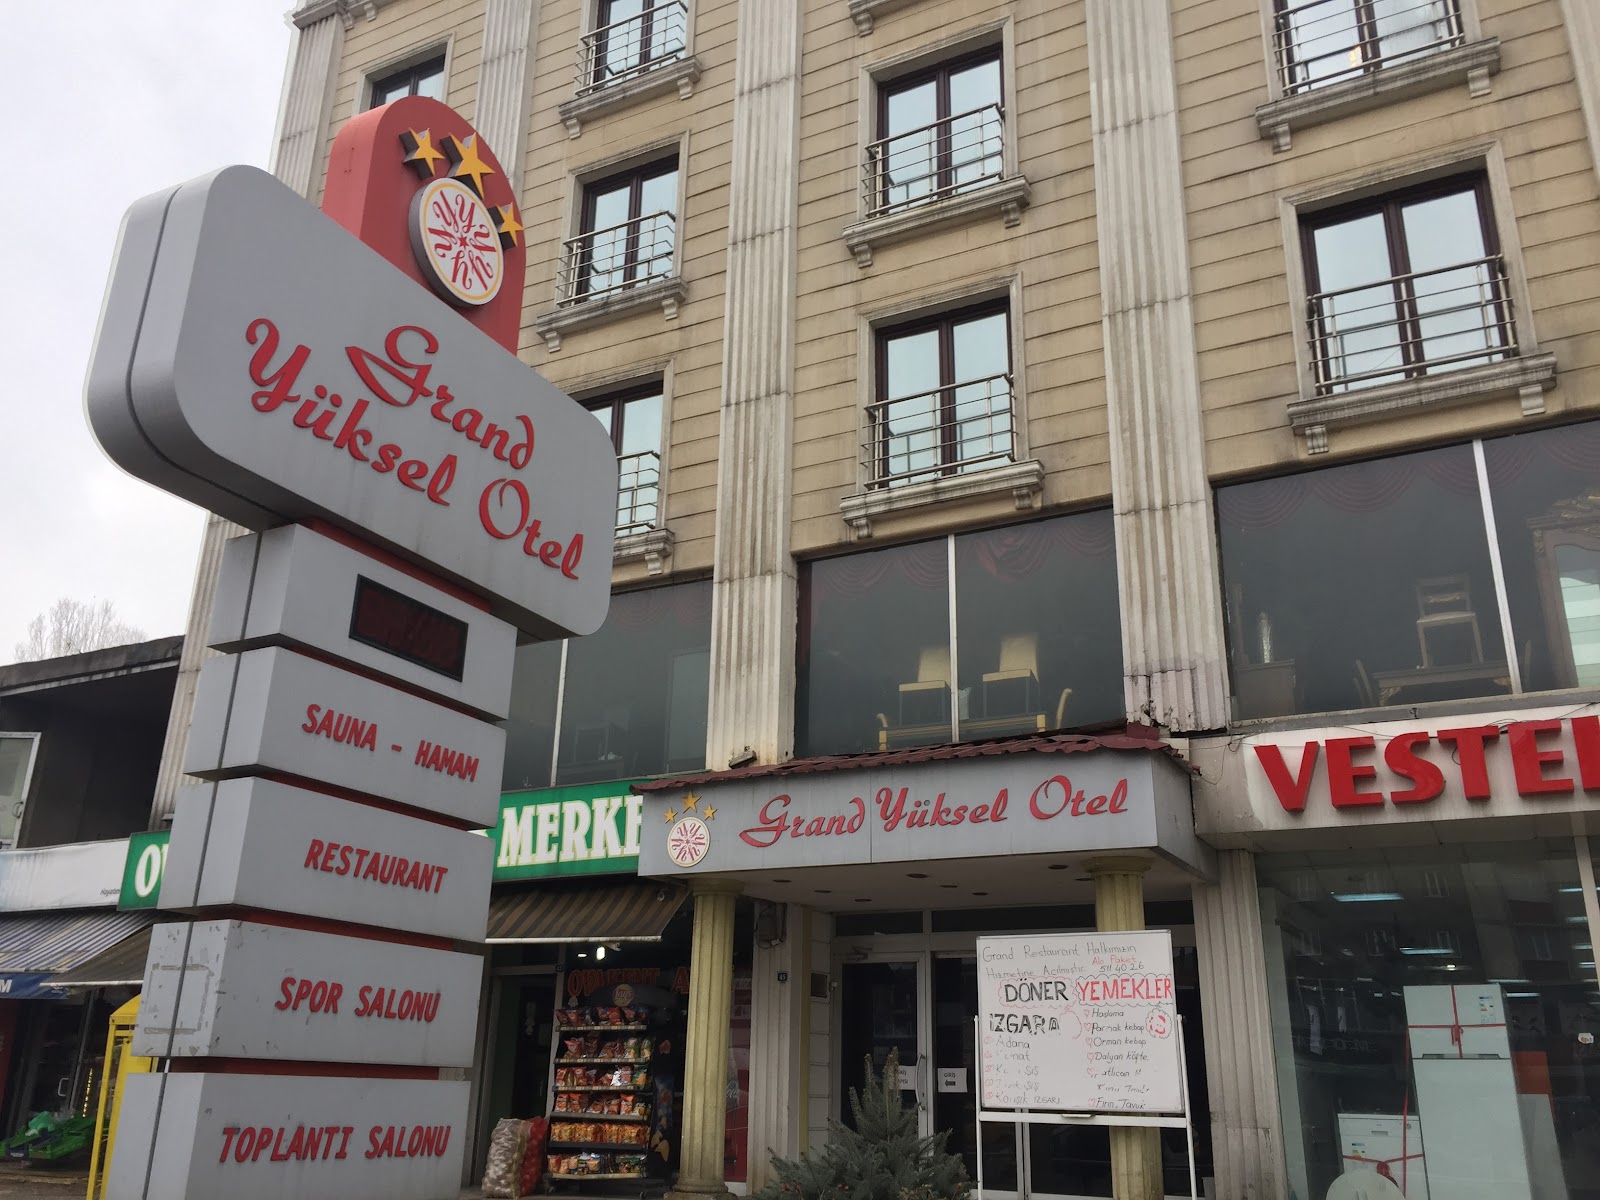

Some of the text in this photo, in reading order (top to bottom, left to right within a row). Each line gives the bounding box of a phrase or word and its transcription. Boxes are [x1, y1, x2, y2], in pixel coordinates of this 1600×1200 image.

[345, 325, 534, 470] Grand
[245, 318, 584, 580] Yüksel Otel
[302, 703, 378, 751] SAUNA
[415, 739, 480, 783] HAMAM
[739, 774, 1128, 848] Grand Yüksel Otel
[135, 843, 168, 898] O
[304, 838, 448, 894] RESTAURANT
[983, 946, 1014, 962] Grand
[1023, 943, 1081, 960] Restaurant
[1110, 954, 1137, 964] Paket
[274, 976, 442, 1023] SPOR SALONU
[1004, 978, 1173, 1002] DÖNER YEMEKLER
[996, 1034, 1031, 1049] Adana
[1094, 1036, 1147, 1048] Orman kebap
[1095, 1051, 1123, 1064] Dalyan
[219, 1125, 451, 1164] TOPLANTI SALONU
